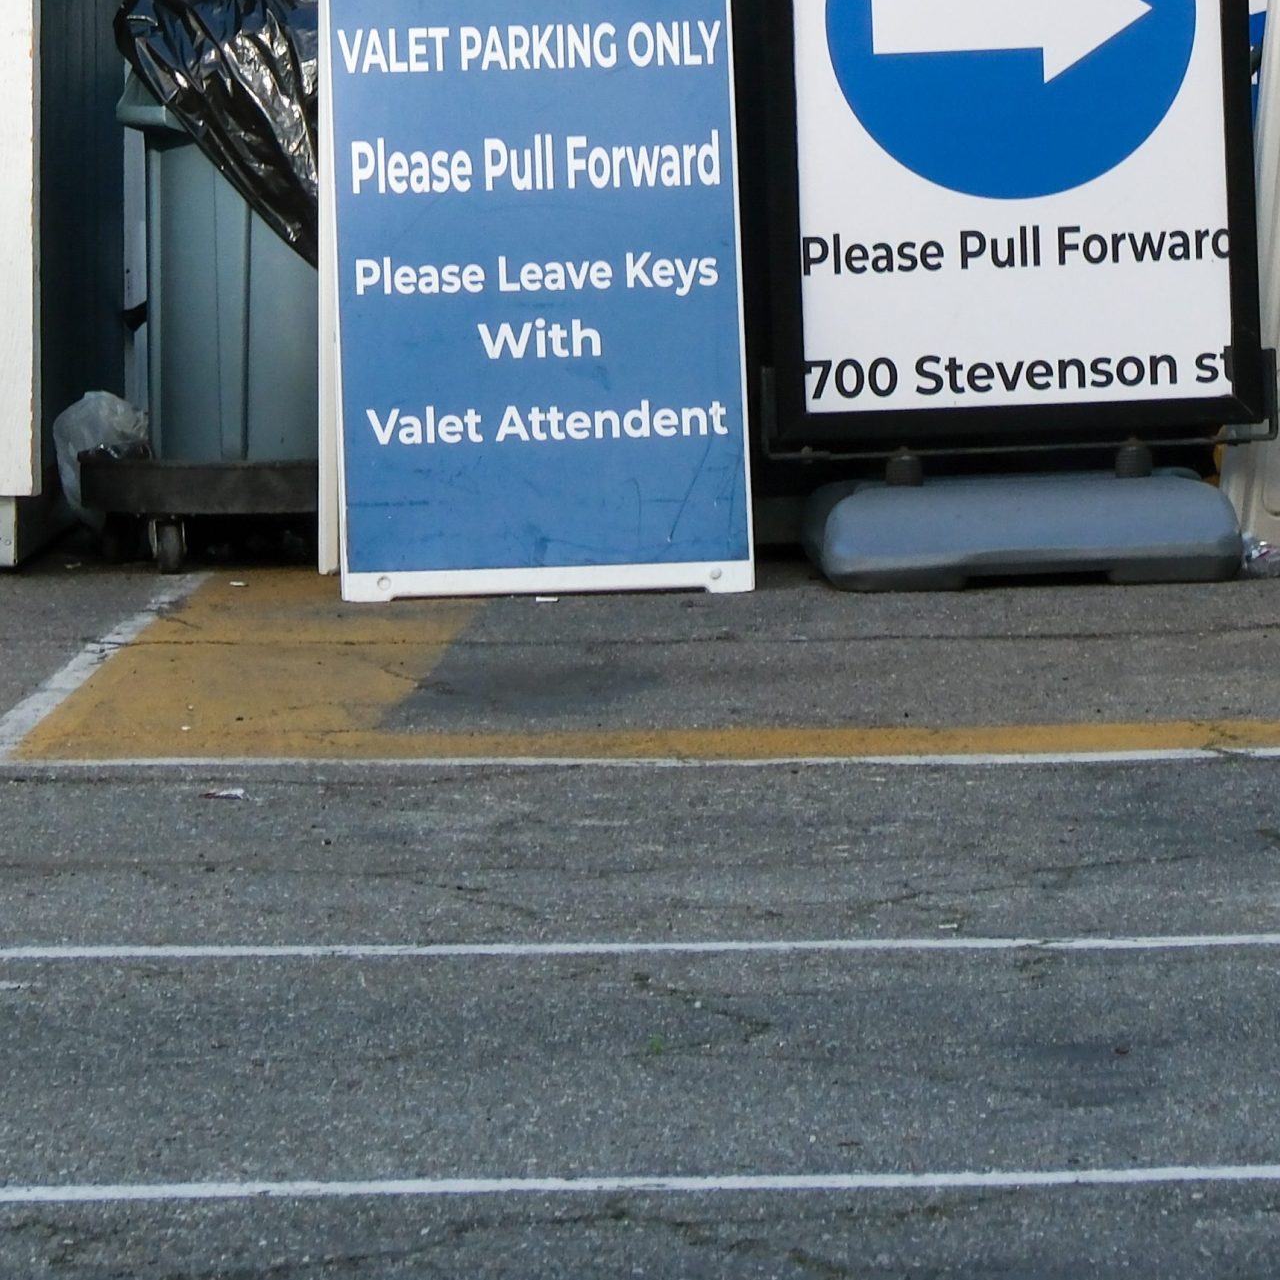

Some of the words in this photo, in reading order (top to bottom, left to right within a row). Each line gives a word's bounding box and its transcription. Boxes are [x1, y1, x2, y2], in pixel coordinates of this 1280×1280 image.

[337, 28, 449, 73] VALET
[461, 23, 616, 70] PARKING
[628, 21, 720, 67] ONLY
[352, 138, 472, 194] Please
[484, 134, 553, 190] Pull
[567, 130, 720, 188] Forward
[802, 234, 944, 276] Please
[960, 226, 1040, 269] Pull
[356, 257, 484, 295] Please
[499, 256, 612, 291] Leave
[626, 252, 718, 296] Keys
[478, 318, 601, 359] With
[804, 357, 898, 399] 700
[915, 355, 1177, 395] Stevenson
[366, 406, 483, 444] Valet
[496, 400, 728, 441] Attendent
